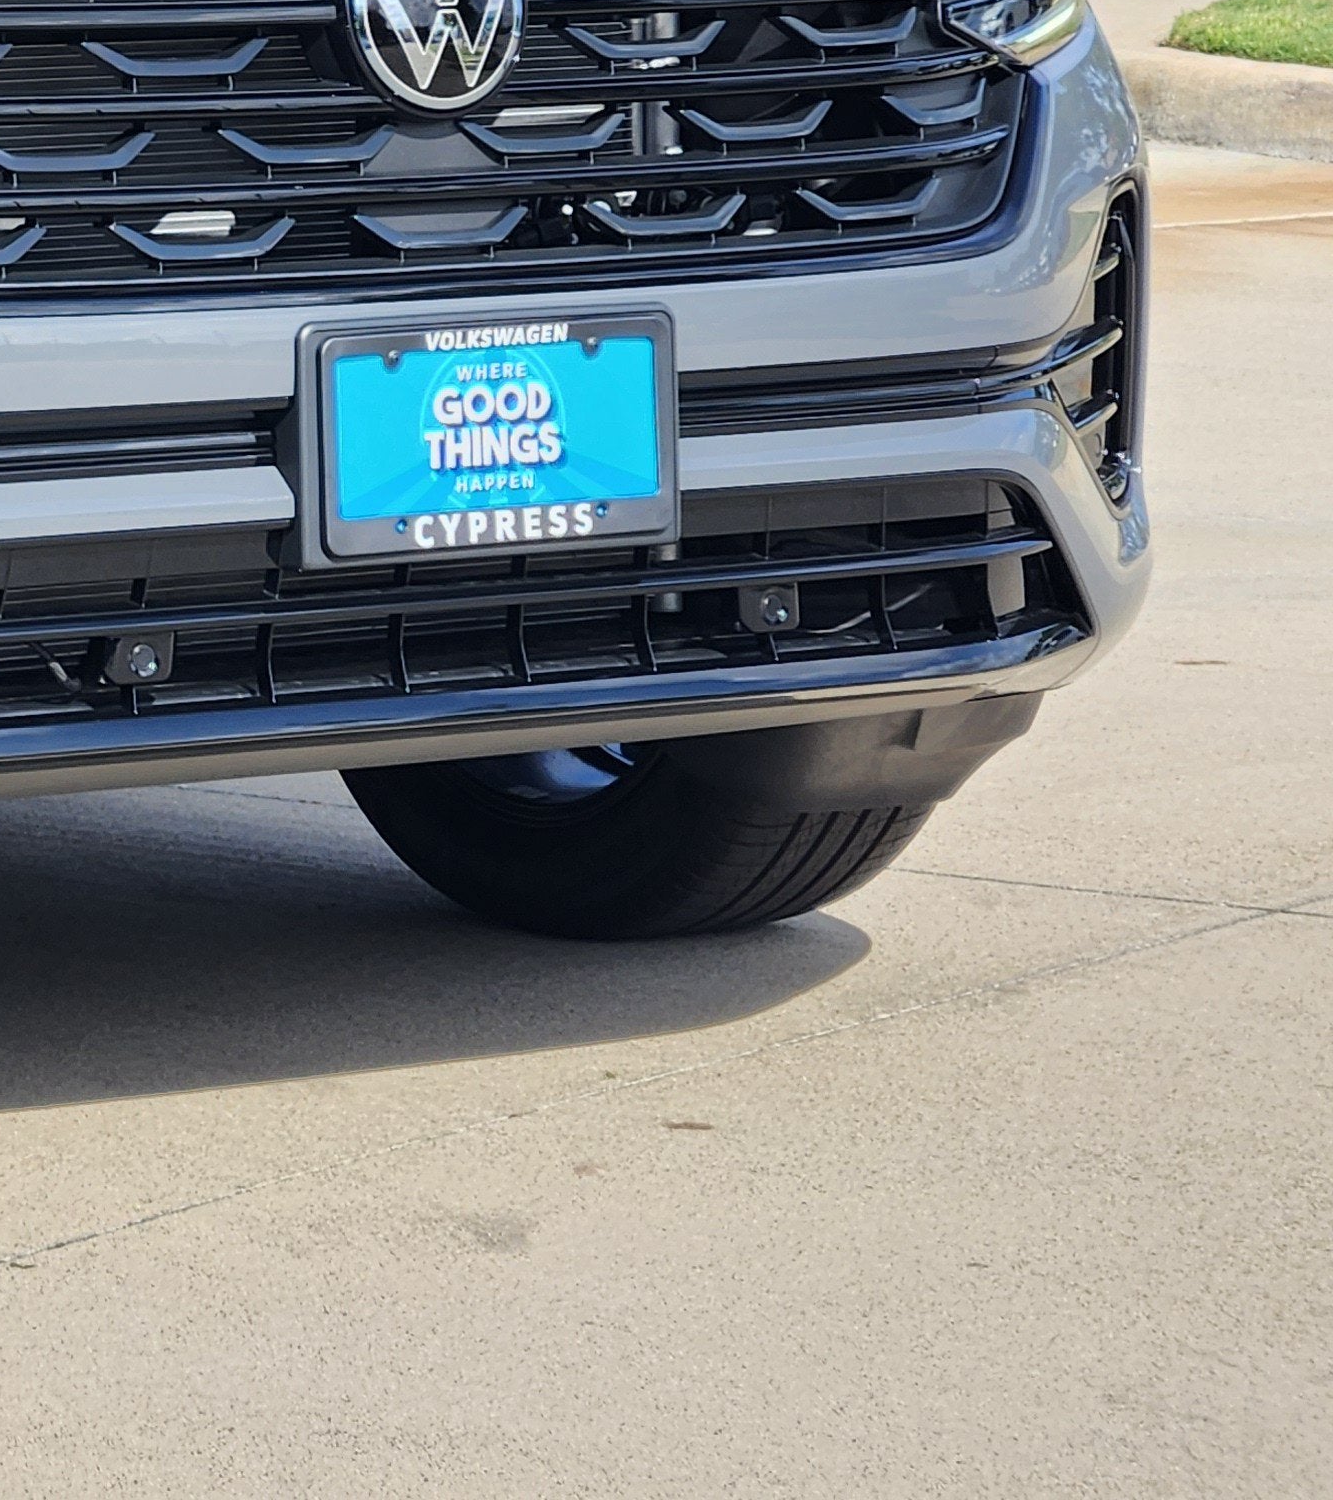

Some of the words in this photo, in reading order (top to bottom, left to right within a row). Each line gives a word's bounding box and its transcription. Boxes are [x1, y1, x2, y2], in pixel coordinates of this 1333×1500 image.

[425, 323, 569, 351] VOLKSWAGEN
[455, 361, 527, 382] WHERE
[434, 382, 552, 425] GOOD
[424, 424, 563, 469] THINGS
[455, 473, 535, 493] HAPPEN
[413, 503, 594, 549] CYPRESS
